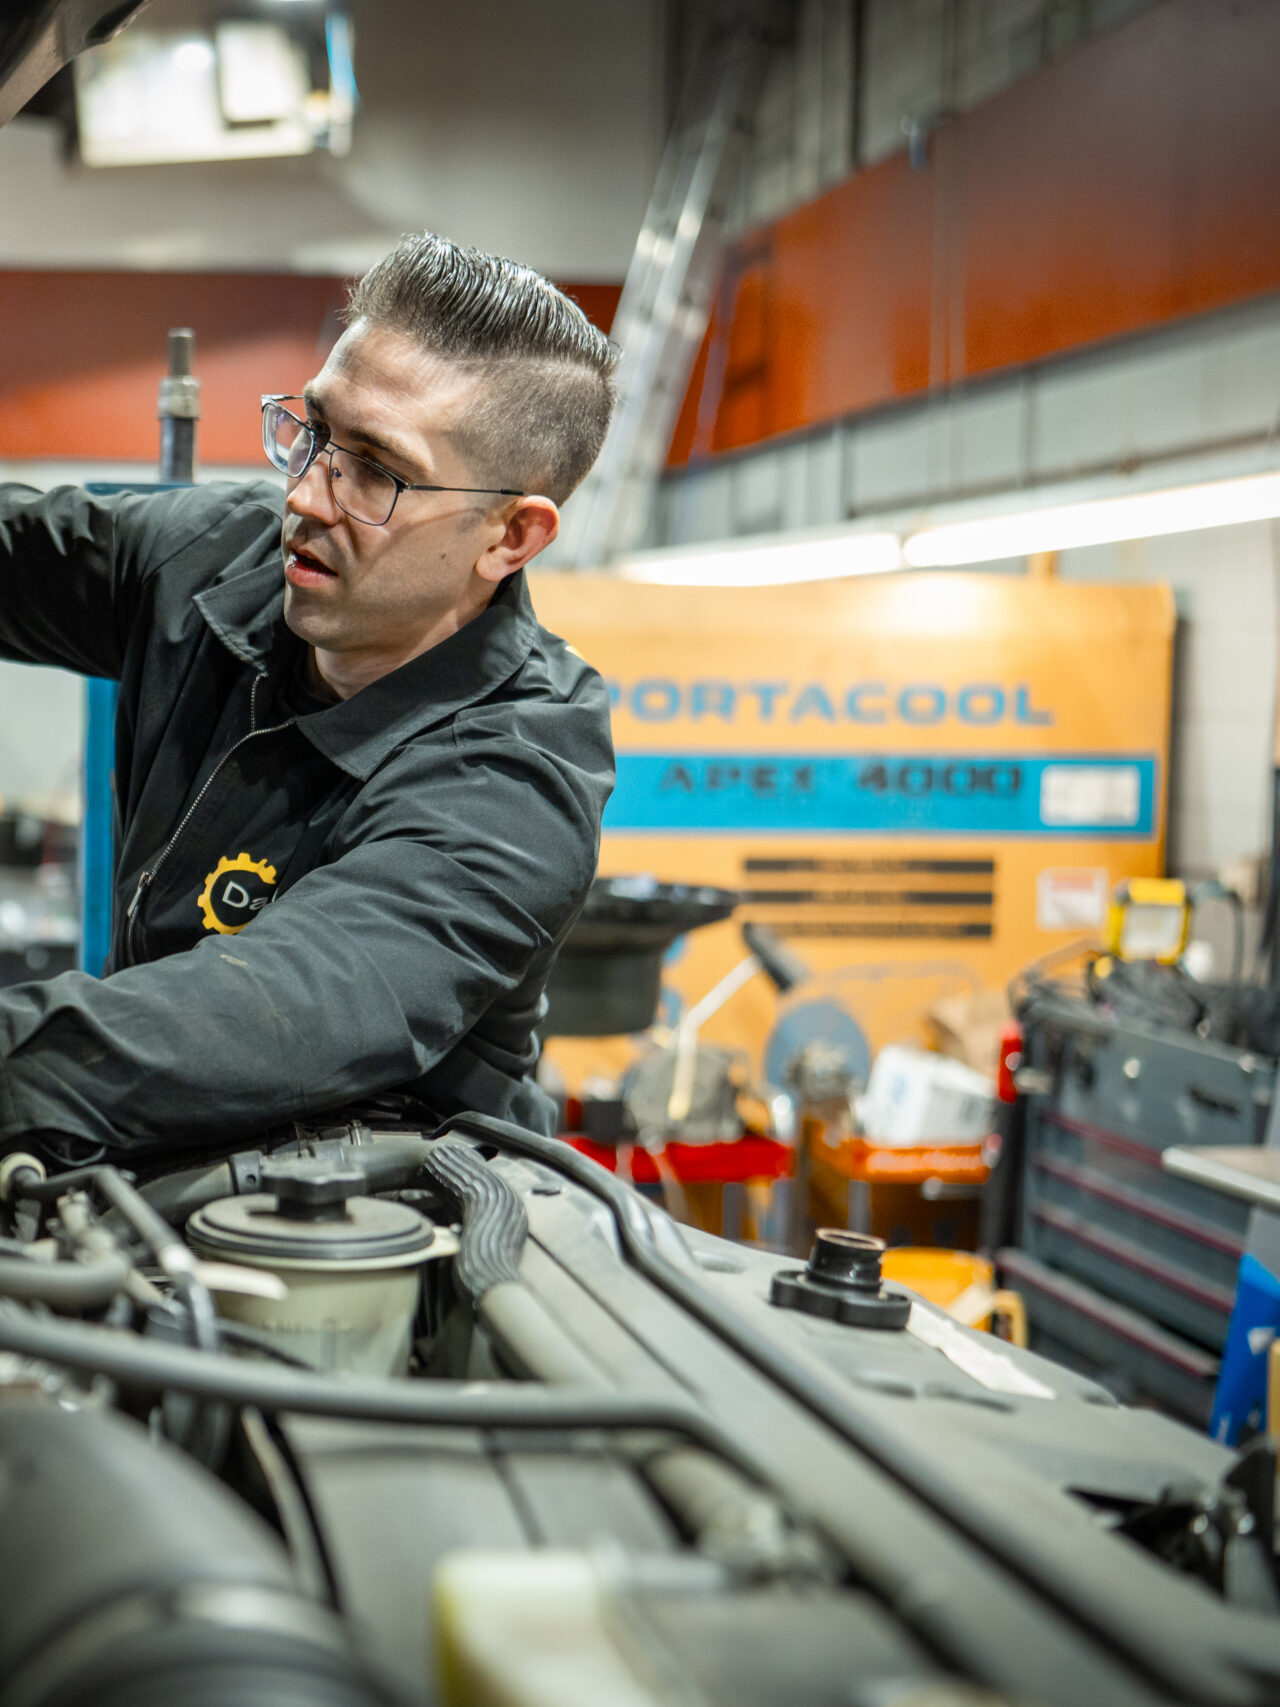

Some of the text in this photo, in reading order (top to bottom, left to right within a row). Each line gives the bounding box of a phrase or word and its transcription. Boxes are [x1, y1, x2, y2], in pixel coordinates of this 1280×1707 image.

[609, 678, 1055, 727] ORTACOOL
[662, 763, 1024, 798] APEX 4000
